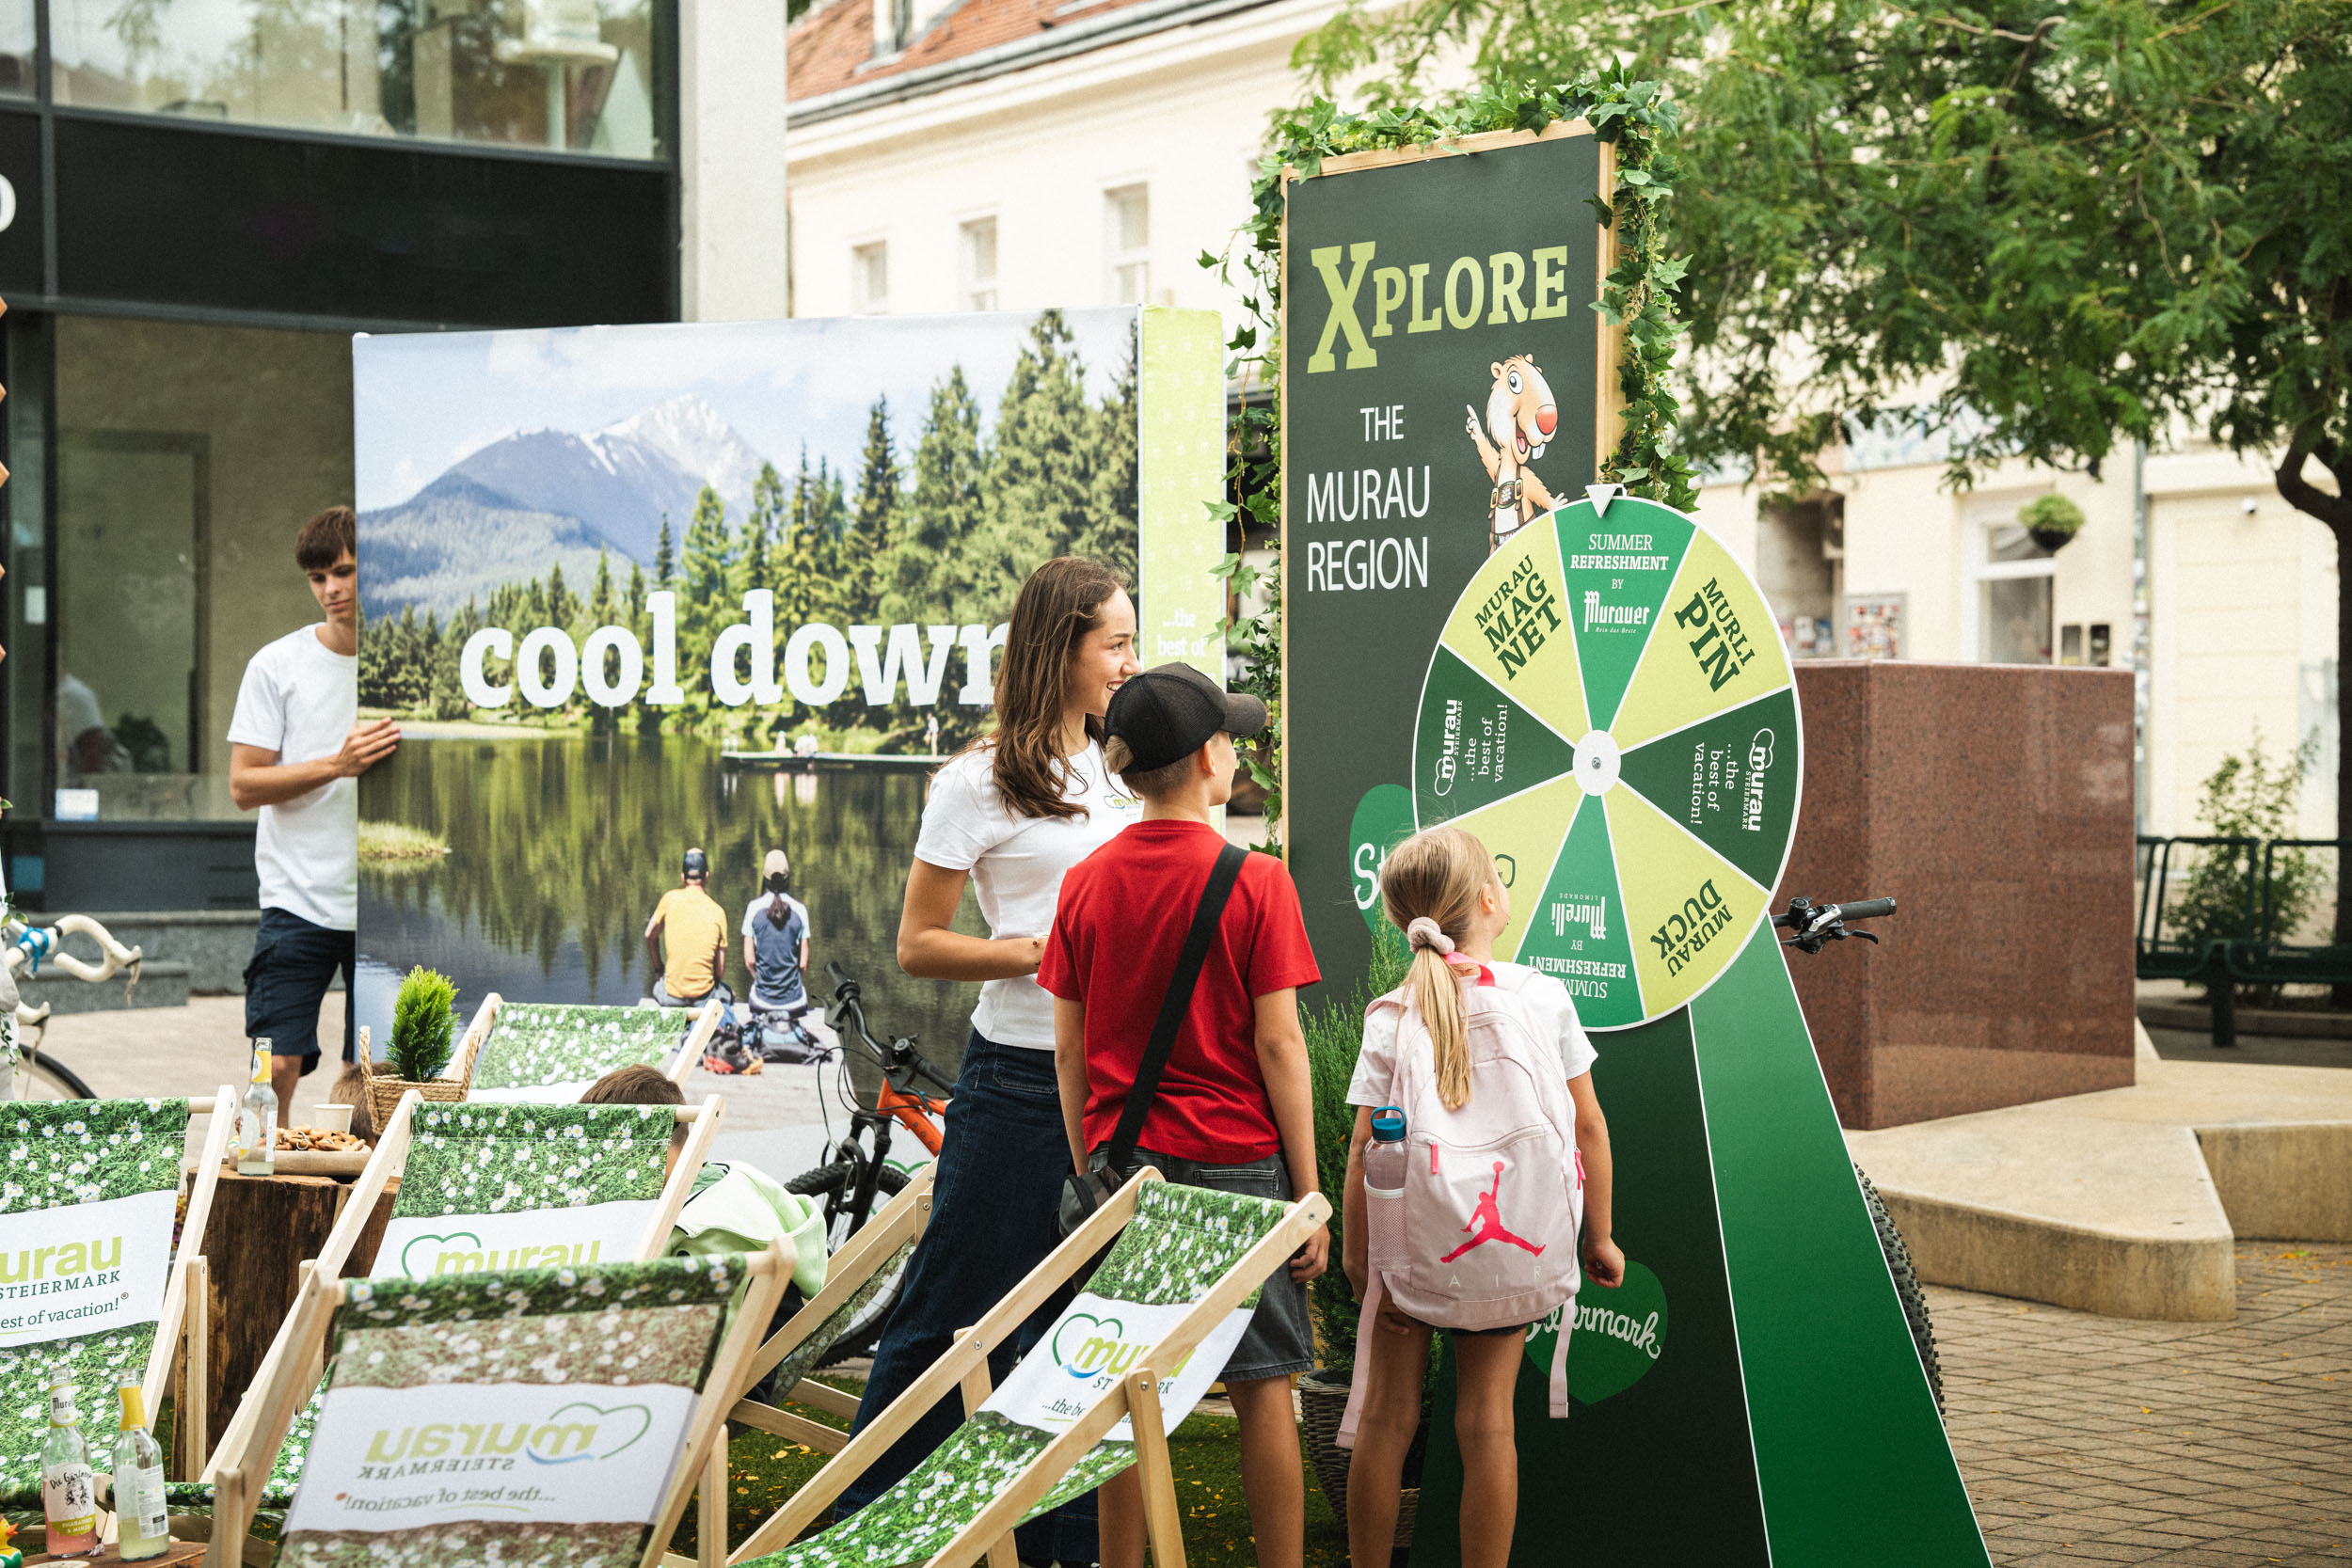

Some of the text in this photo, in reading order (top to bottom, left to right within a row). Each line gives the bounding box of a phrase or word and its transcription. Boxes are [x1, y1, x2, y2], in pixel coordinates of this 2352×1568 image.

[1307, 241, 1568, 373] XPLORE
[1359, 404, 1405, 442] THE
[1307, 466, 1431, 523] MURAU
[1307, 537, 1428, 592] REGION
[1569, 555, 1669, 570] REFRESHMENT
[1588, 533, 1653, 551] SUMMER
[1474, 554, 1534, 629] MURAU
[1484, 572, 1547, 653] MAG
[1583, 590, 1650, 633] Murauer
[1612, 578, 1624, 589] BY
[459, 590, 685, 708] cool
[1156, 634, 1187, 657] best
[1497, 594, 1562, 681] NET
[1674, 592, 1740, 692] PIN
[1702, 577, 1756, 666] MURLI
[1441, 699, 1458, 779] murau
[1454, 700, 1463, 755] STEIERMARK
[1477, 717, 1493, 775] best of
[1494, 704, 1508, 783] vacation!
[1690, 741, 1705, 824] vacation!
[1707, 750, 1724, 812] best of
[1741, 770, 1751, 831] STEIERMARK
[1748, 746, 1767, 832] murau
[1551, 896, 1607, 940] Murelli
[1559, 893, 1598, 901] LIMONADE
[1650, 878, 1723, 959] DUCK
[1570, 940, 1583, 950] BY
[1667, 904, 1733, 977] MURAU
[1561, 978, 1608, 998] SUMM
[0, 1235, 122, 1284] urau
[0, 1315, 24, 1329] est
[27, 1309, 46, 1325] of
